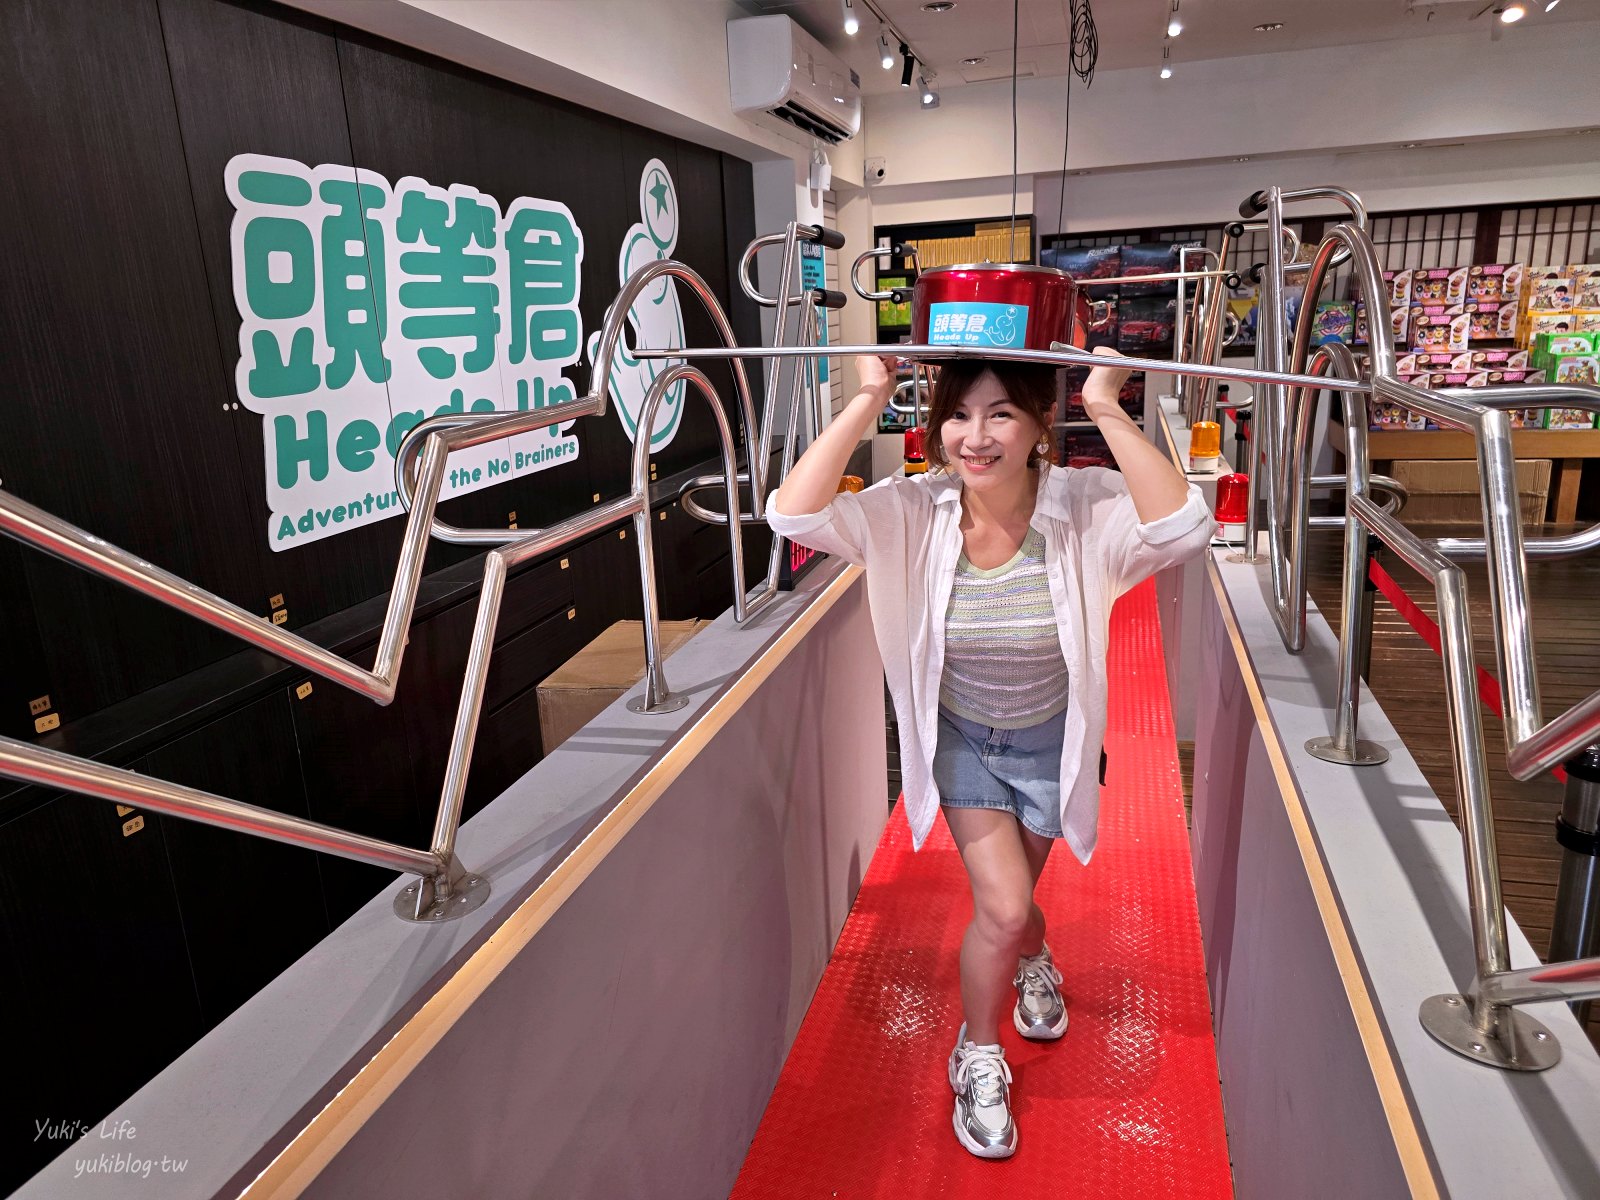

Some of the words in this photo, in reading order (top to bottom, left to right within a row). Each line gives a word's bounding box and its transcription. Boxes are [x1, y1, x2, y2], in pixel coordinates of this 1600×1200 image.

[238, 170, 579, 399] 頭等倉
[933, 313, 987, 333] 頭等倉
[933, 333, 961, 341] Heads
[965, 333, 980, 342] Up
[277, 491, 399, 541] Adventur
[450, 467, 482, 489] the
[488, 458, 510, 478] No
[515, 441, 576, 470] Brainers
